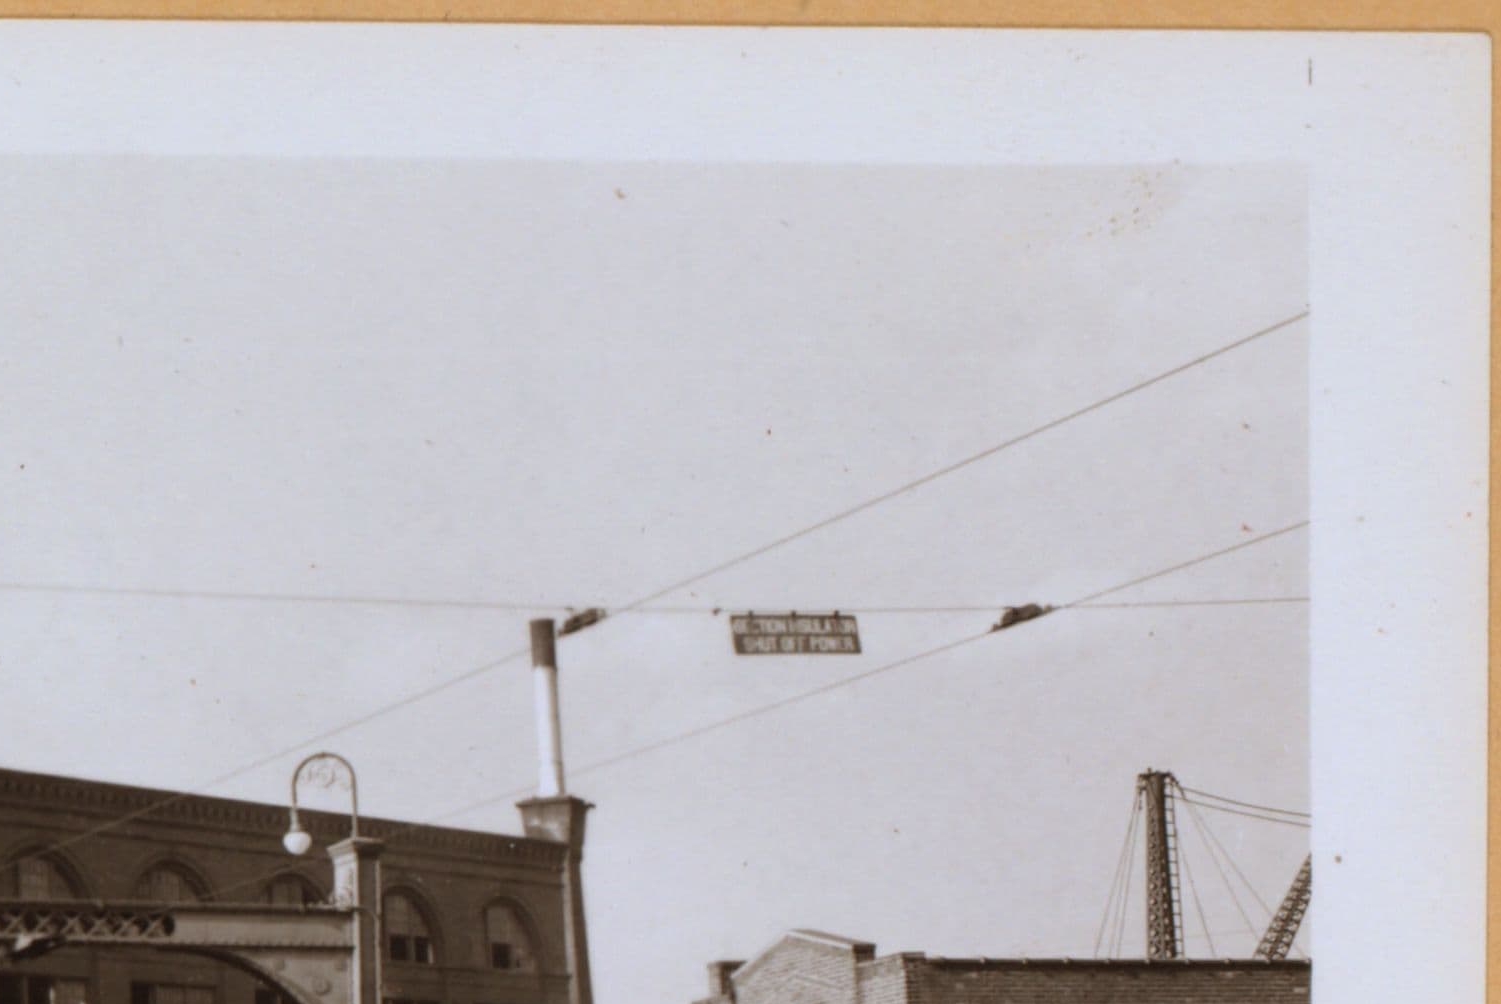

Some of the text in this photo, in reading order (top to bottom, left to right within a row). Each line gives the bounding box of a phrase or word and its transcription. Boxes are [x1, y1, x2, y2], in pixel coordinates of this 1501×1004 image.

[743, 635, 855, 651] SHUT OFF POWER
